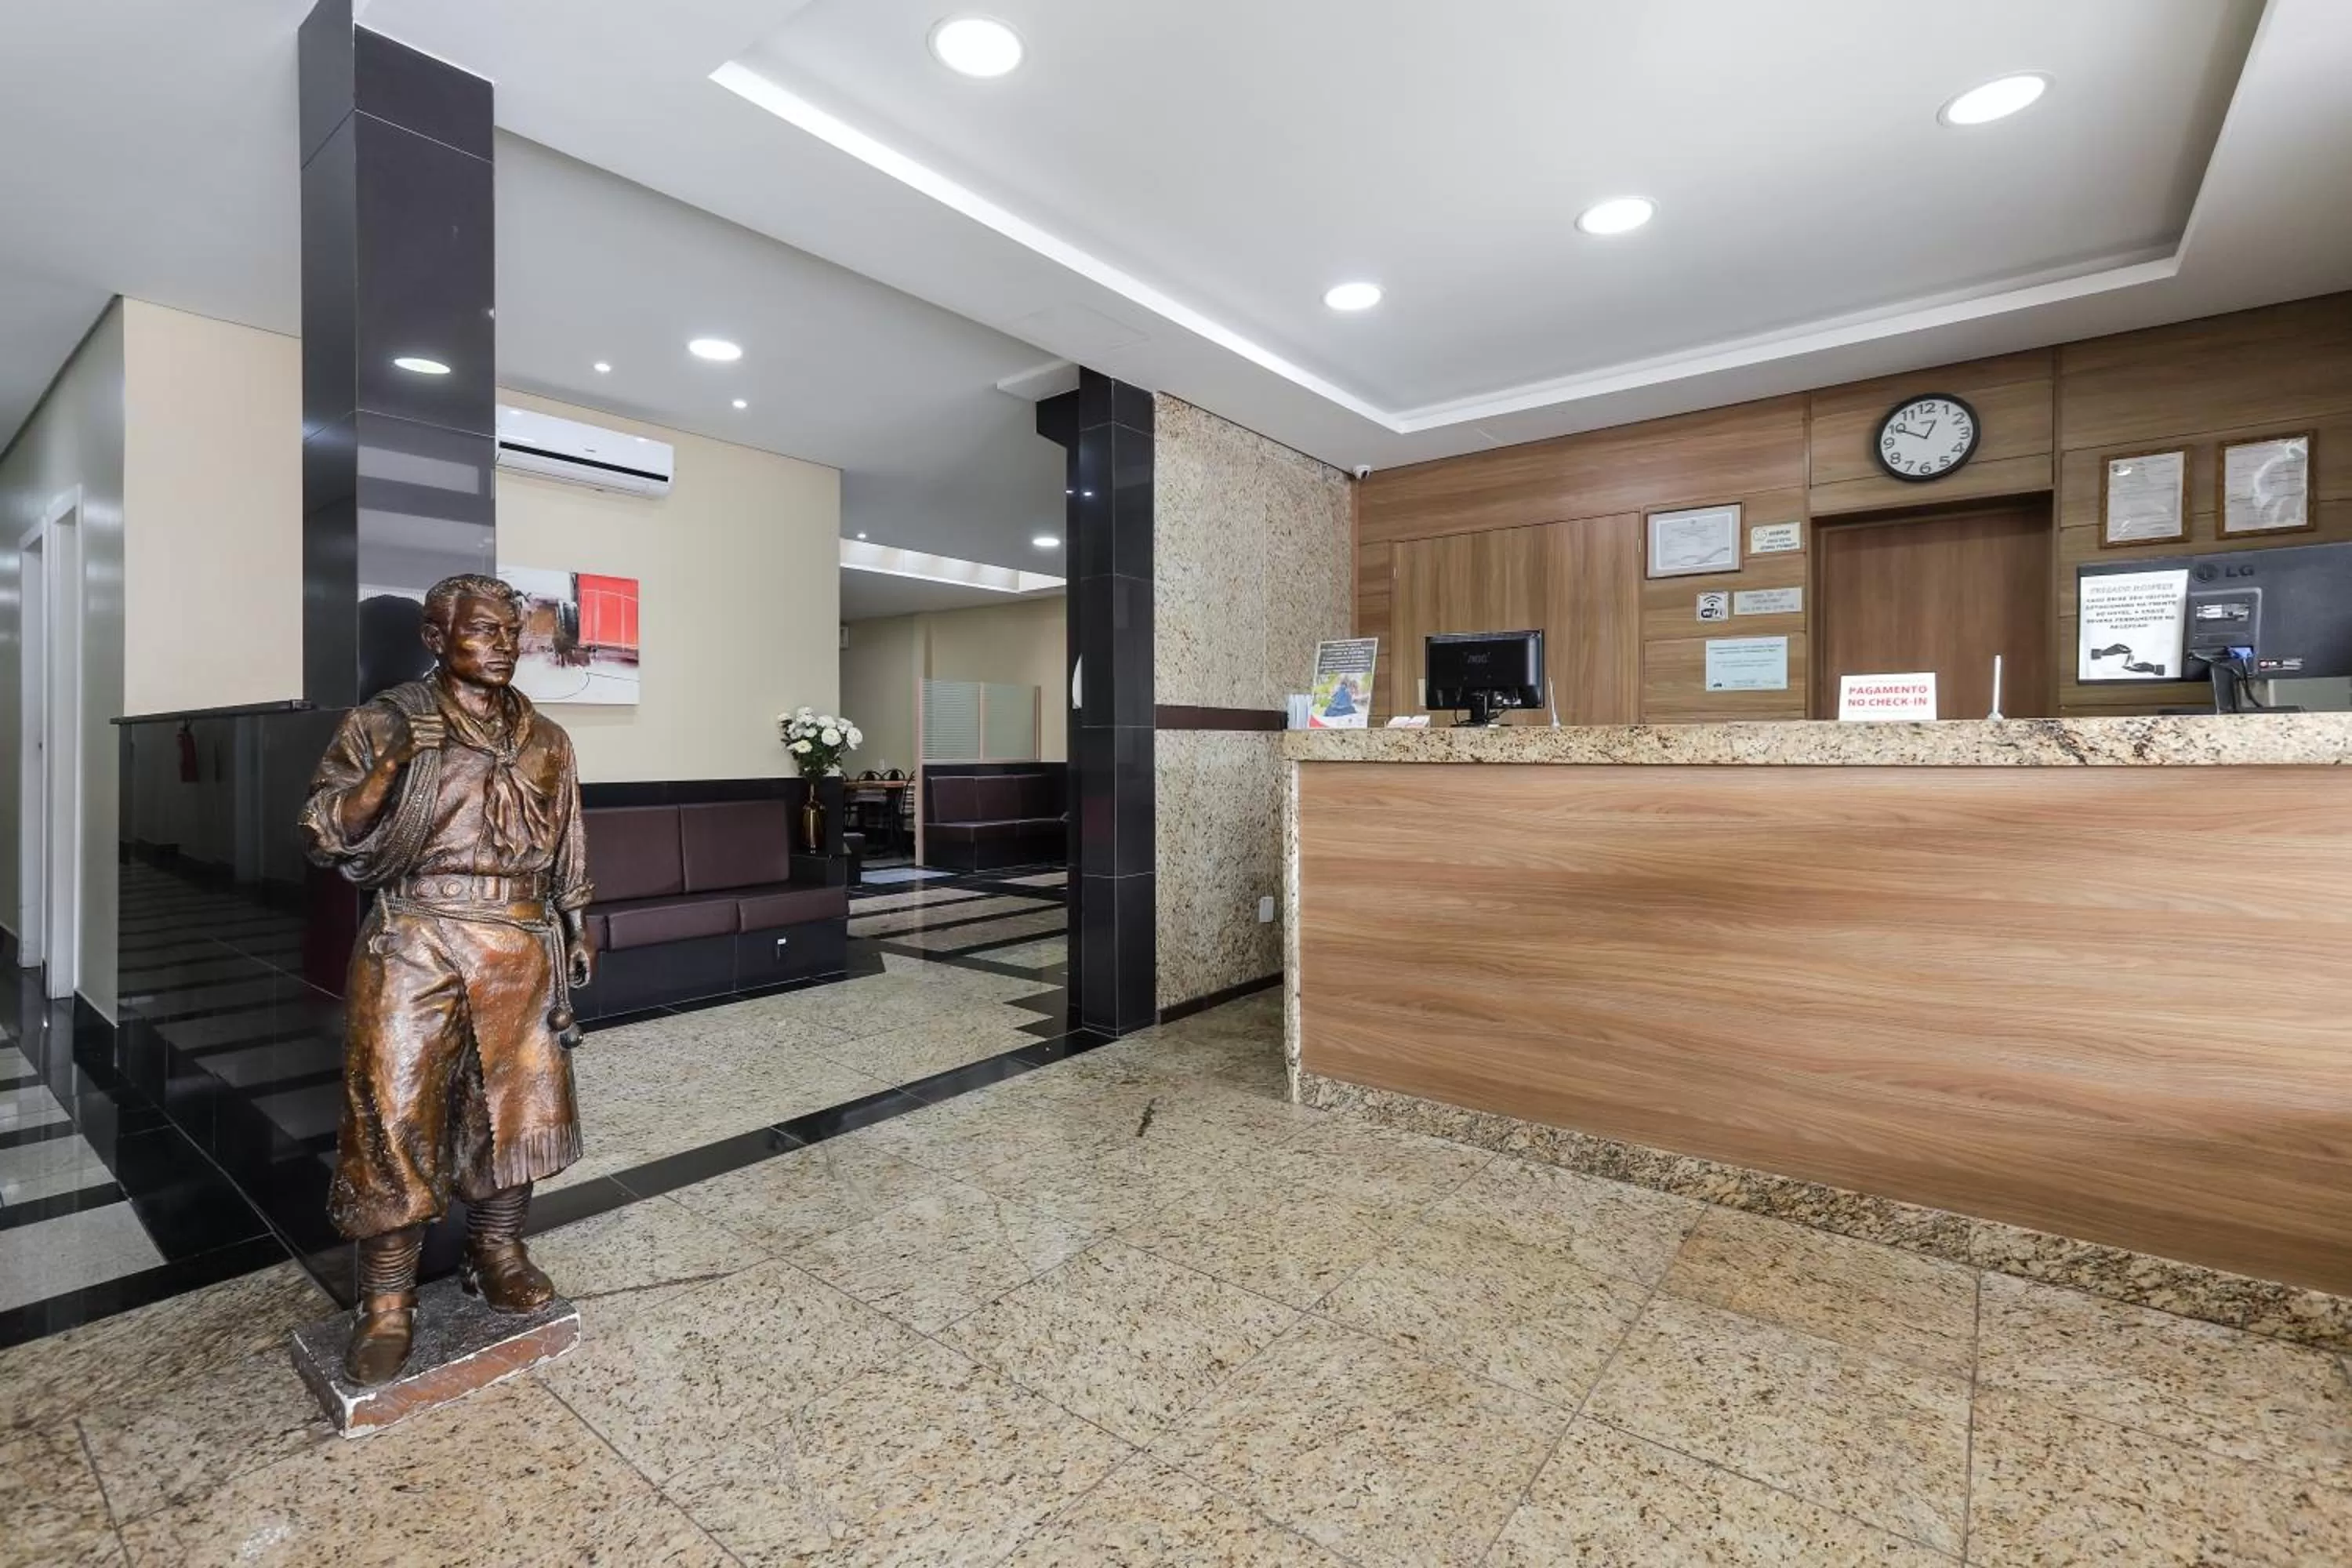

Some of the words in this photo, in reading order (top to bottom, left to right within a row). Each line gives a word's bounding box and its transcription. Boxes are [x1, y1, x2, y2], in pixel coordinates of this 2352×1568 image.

[1917, 402, 1936, 414] 12
[1943, 404, 1949, 415] 1
[1901, 409, 1915, 421] 11
[1953, 412, 1965, 425] 2
[1888, 423, 1906, 434] 10
[1959, 426, 1970, 439] 3
[1883, 437, 1895, 450] 9
[1951, 441, 1965, 453] 4
[1890, 452, 1901, 464] 8
[1939, 456, 1951, 467] 5
[1905, 460, 1916, 472] 7
[1919, 462, 1932, 474] 6
[2225, 564, 2255, 578] LG
[1849, 685, 1928, 695] PAGAMENTO
[1868, 697, 1928, 706] CHECK-IN
